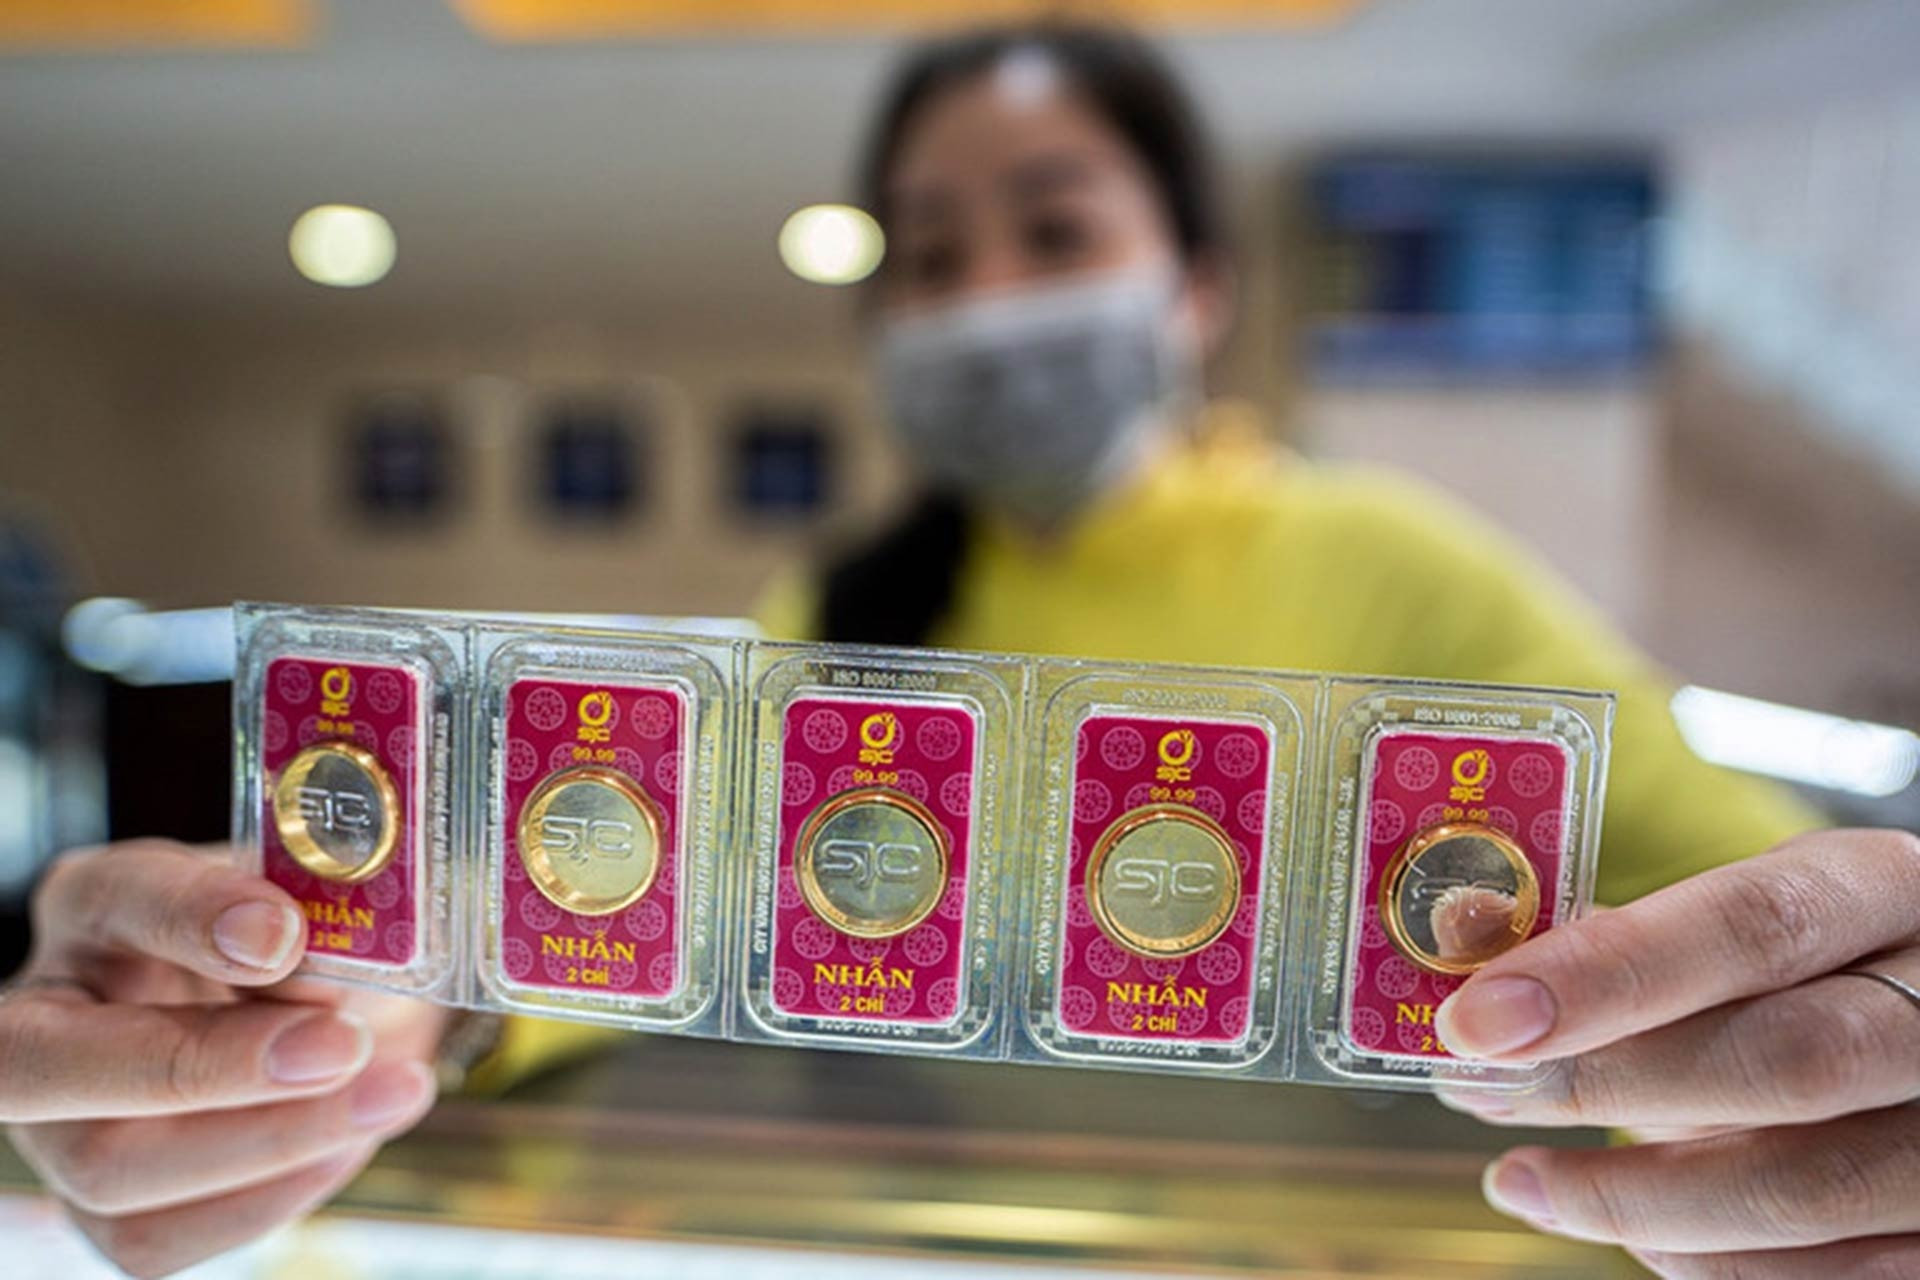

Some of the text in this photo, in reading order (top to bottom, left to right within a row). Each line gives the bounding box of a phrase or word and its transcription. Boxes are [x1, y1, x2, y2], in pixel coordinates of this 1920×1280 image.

[577, 727, 611, 744] SJC
[571, 745, 617, 763] 99.99
[858, 748, 894, 767] SJC
[852, 768, 899, 786] 99.99
[1155, 765, 1192, 784] SJC
[1149, 786, 1197, 803] 99.99
[1449, 786, 1485, 804] SJC
[1442, 804, 1489, 822] 99.99
[541, 815, 634, 863] SJC
[820, 838, 921, 889] SJC
[1114, 858, 1216, 905] SJC
[542, 929, 636, 964] NHẪN
[566, 967, 577, 983] 2
[814, 956, 914, 989] NHẪN
[1106, 974, 1208, 1009] NHẪN
[840, 997, 851, 1012] 2
[1132, 1015, 1143, 1031] 2
[1421, 1036, 1432, 1051] 2
